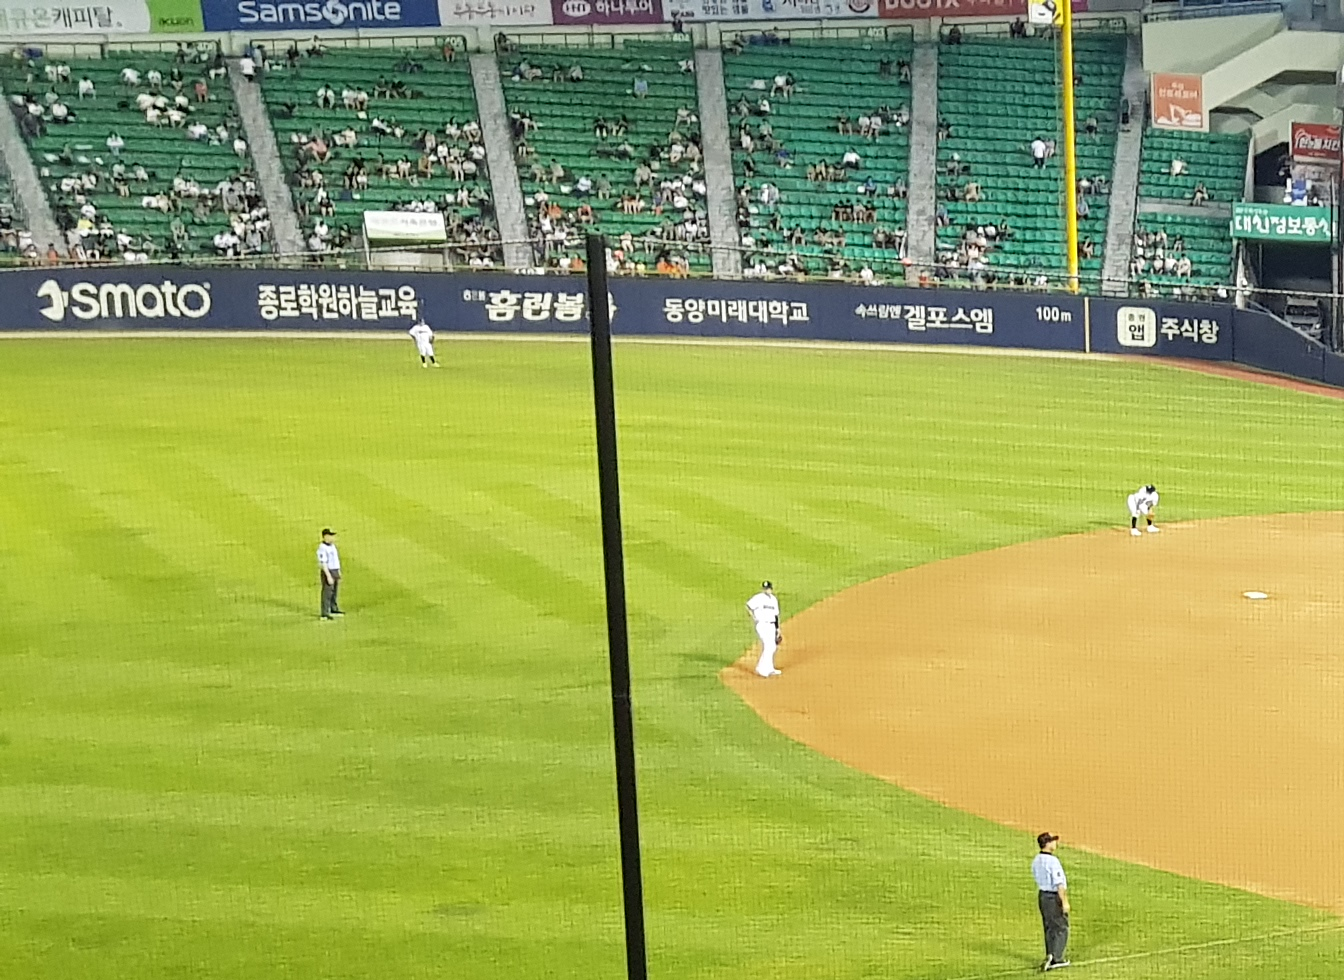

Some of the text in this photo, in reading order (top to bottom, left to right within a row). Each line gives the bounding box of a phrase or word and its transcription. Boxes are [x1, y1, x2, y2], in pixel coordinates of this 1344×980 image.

[0, 5, 113, 28] 큐온캐피탈
[71, 281, 211, 319] smato
[257, 284, 420, 321] 종로학원하늘교육
[485, 290, 618, 323] 홈런볼
[663, 298, 810, 325] 동양미래대학교
[1036, 306, 1073, 322] 100m
[903, 305, 994, 334] 겔포스엠
[1160, 316, 1220, 344] 주식창
